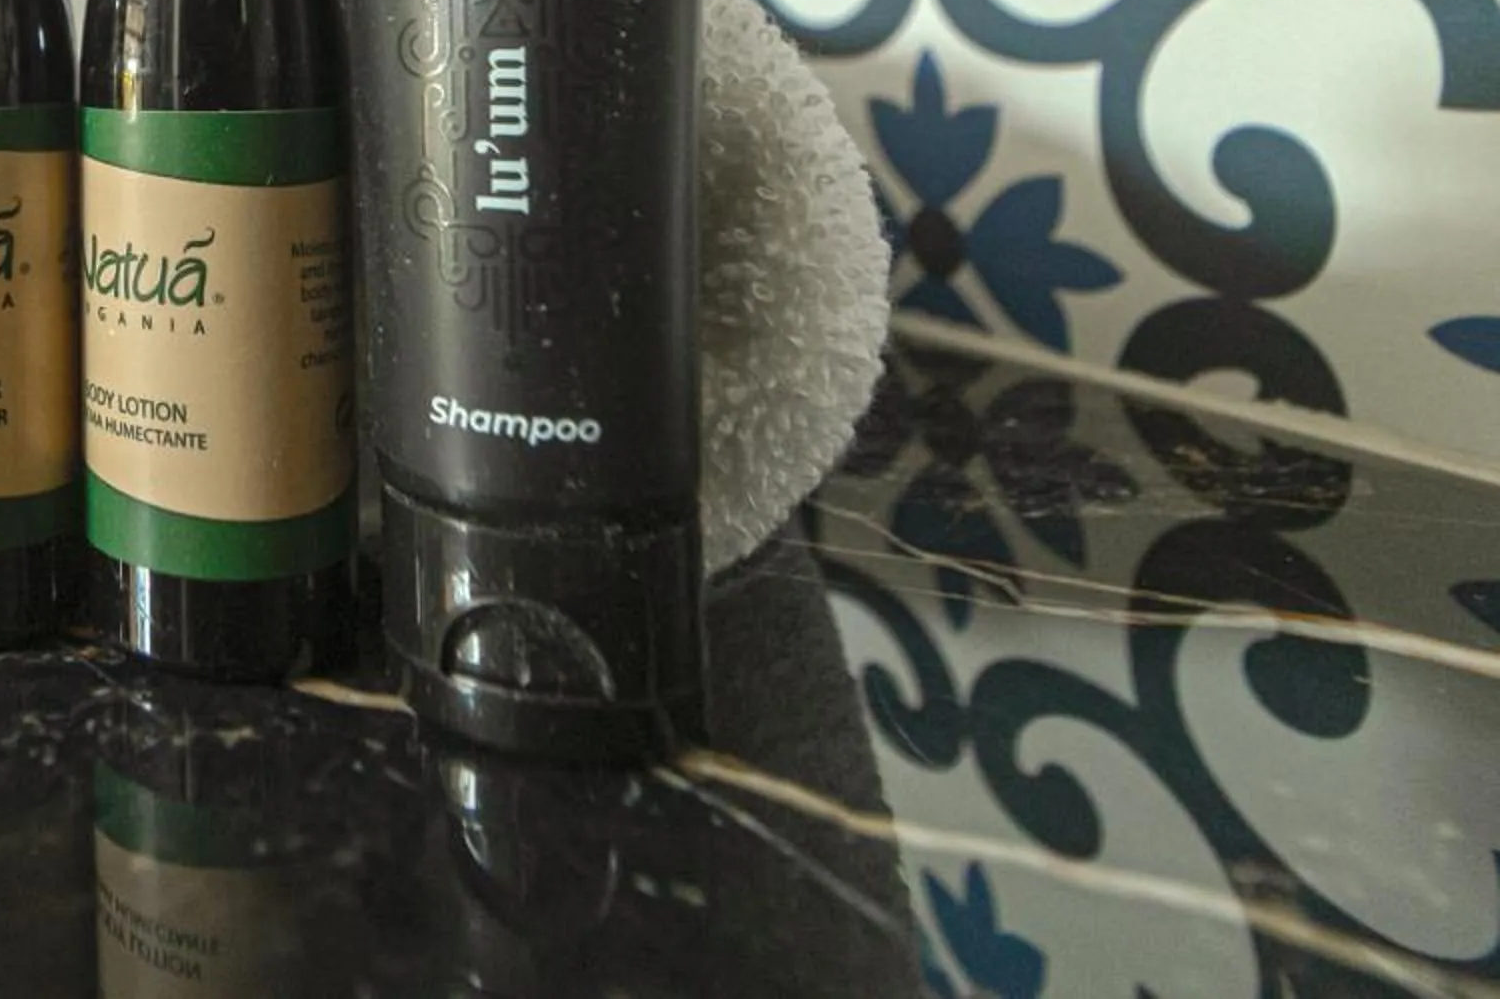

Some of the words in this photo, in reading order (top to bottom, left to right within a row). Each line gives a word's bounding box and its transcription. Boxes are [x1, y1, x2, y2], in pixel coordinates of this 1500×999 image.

[86, 302, 205, 335] GANIA
[118, 394, 188, 424] LOTION
[430, 396, 603, 447] Shampoo
[104, 417, 208, 451] HUMECTANTE
